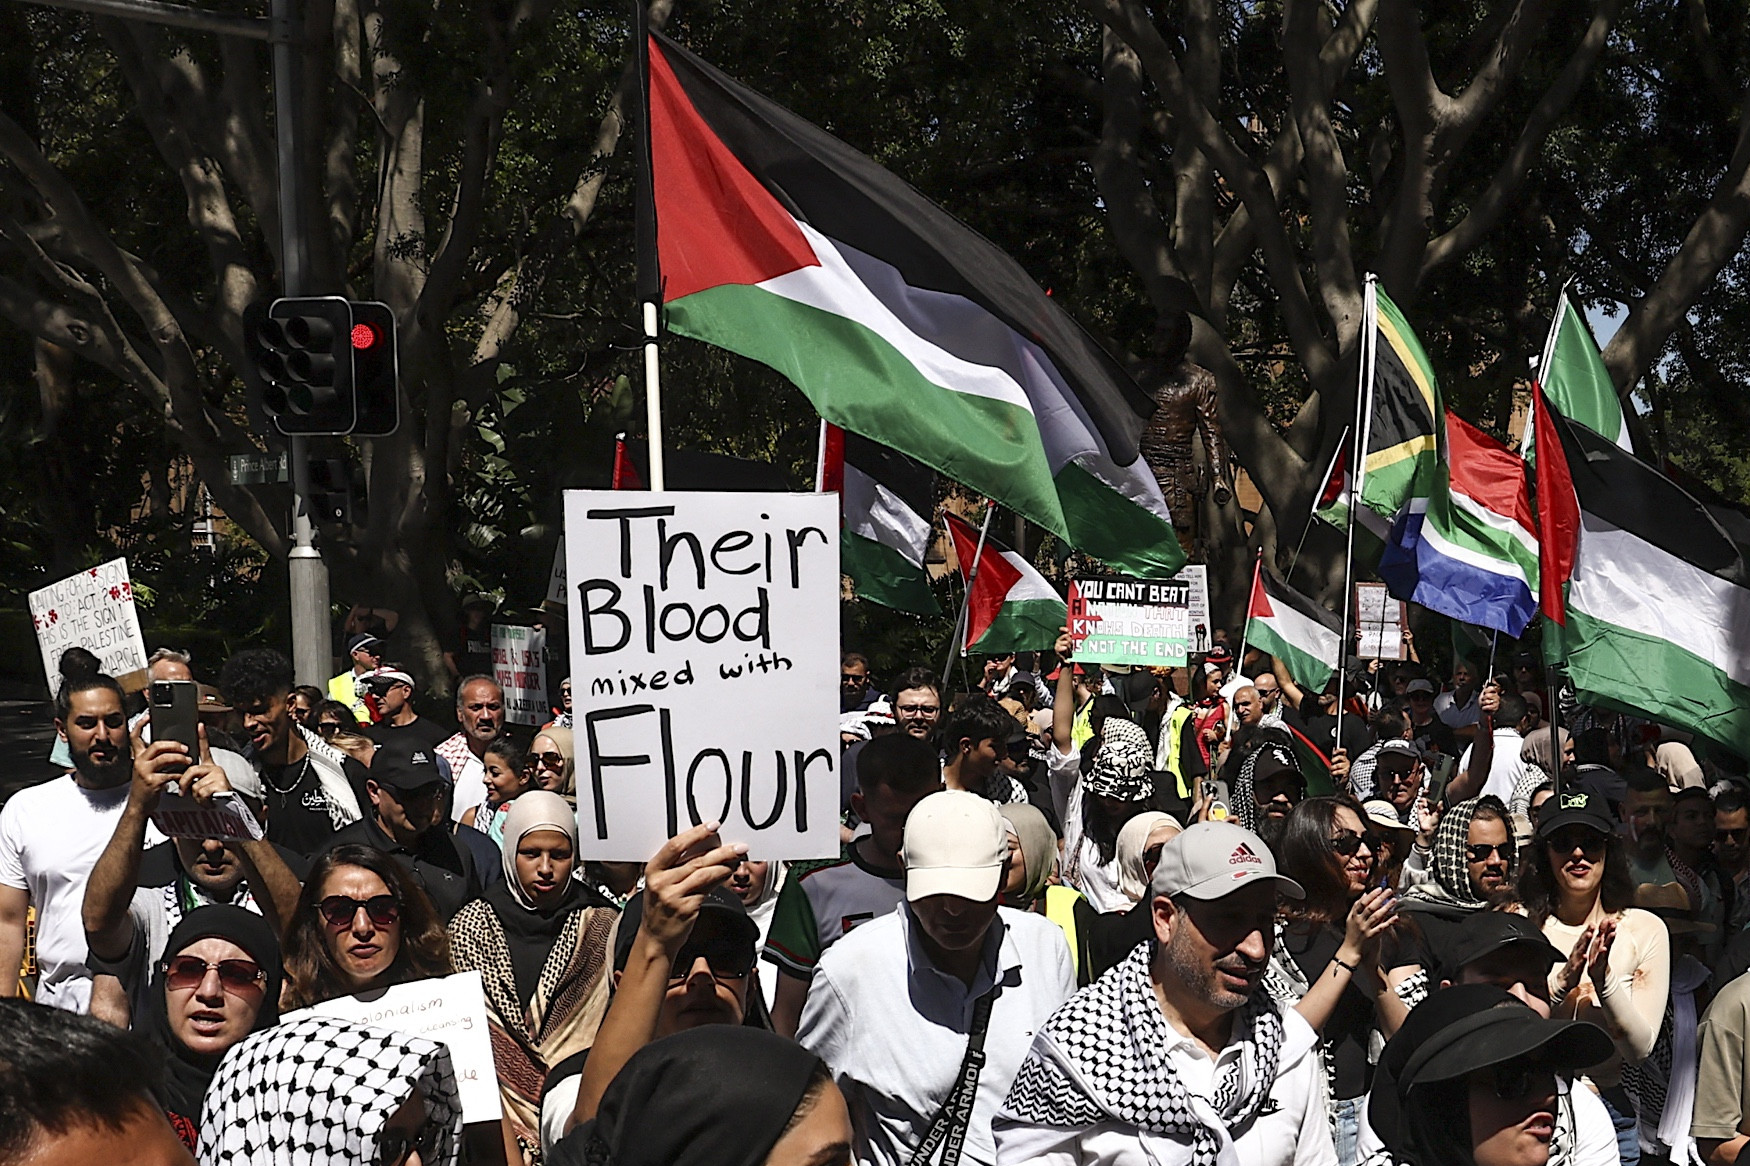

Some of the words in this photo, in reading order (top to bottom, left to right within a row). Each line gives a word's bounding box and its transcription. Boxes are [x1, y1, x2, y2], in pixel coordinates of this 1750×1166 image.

[587, 506, 828, 591] Their
[65, 576, 83, 597] FOR
[98, 562, 125, 588] SIGN
[1075, 580, 1103, 599] YOU
[1106, 582, 1146, 600] CANT
[1149, 585, 1189, 603] BEAT
[59, 603, 72, 620] TO
[78, 593, 97, 615] ACT
[578, 578, 771, 655] Blood
[1143, 605, 1187, 622] THAT
[59, 622, 69, 640] IS
[71, 616, 89, 634] THE
[80, 618, 135, 651] PALESTINE
[1130, 621, 1185, 639] DEATH
[100, 645, 141, 674] MARCH
[1088, 640, 1116, 654] NOT
[1122, 641, 1148, 656] THE
[1155, 642, 1187, 658] END
[591, 660, 695, 697] mixed
[719, 652, 793, 681] with
[585, 704, 834, 840] Flour
[1229, 855, 1262, 865] adidas
